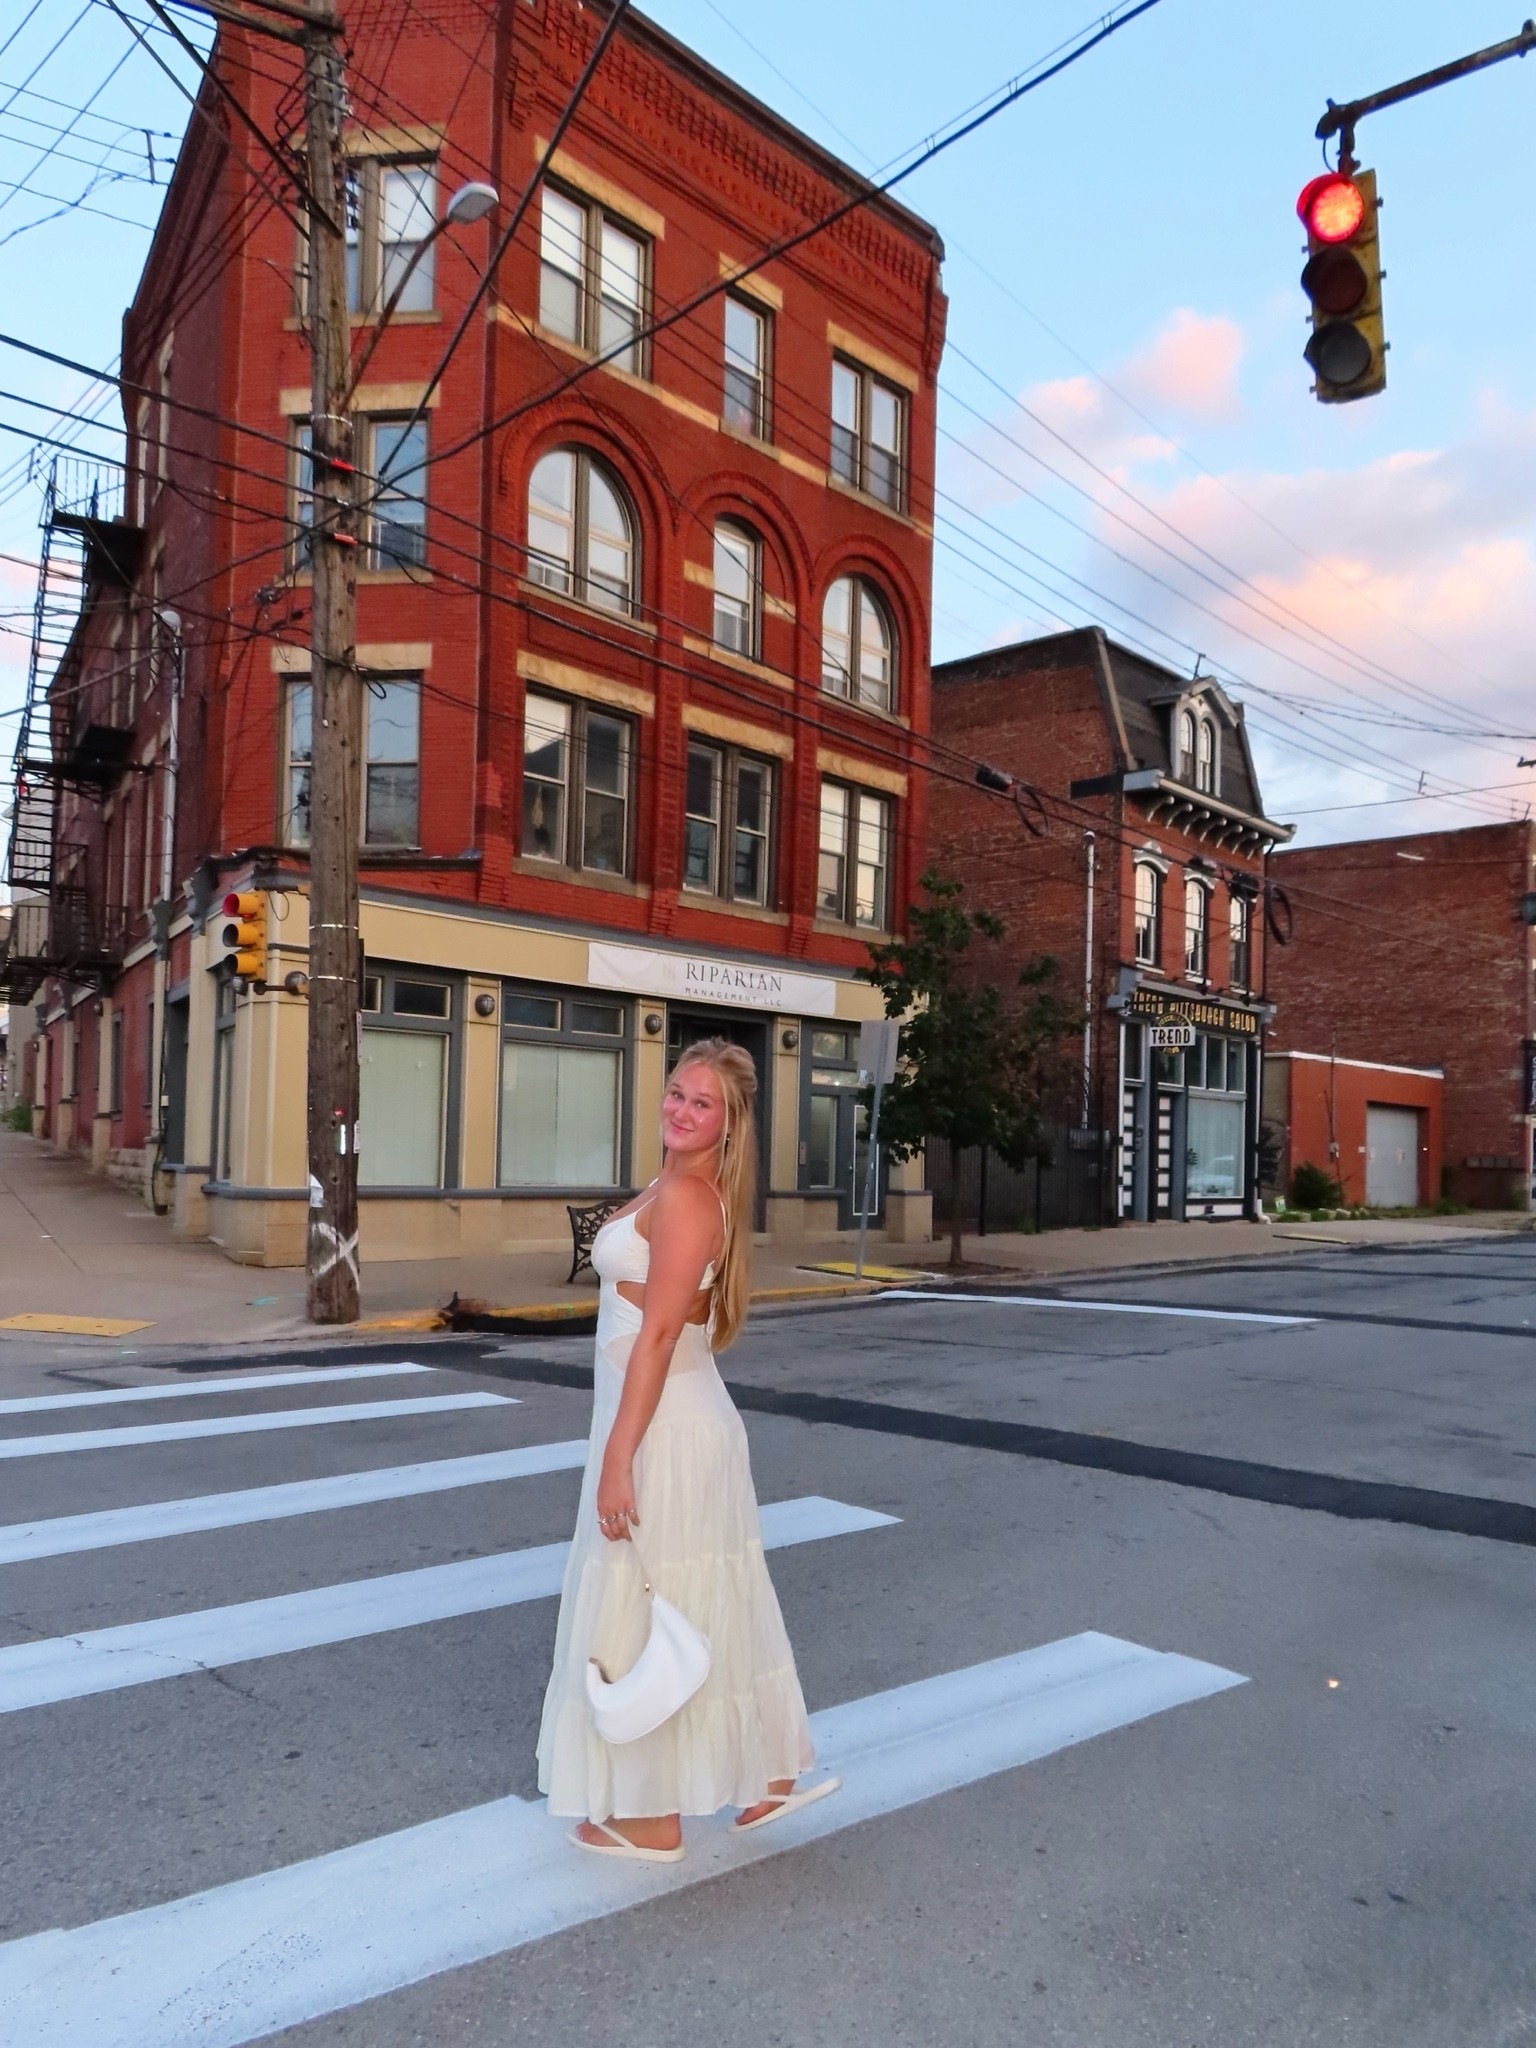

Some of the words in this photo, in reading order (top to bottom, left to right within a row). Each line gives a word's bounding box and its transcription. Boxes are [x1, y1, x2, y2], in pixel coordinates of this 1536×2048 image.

[686, 962, 782, 992] RIPARIAN
[685, 987, 757, 1002] MANAGEMENT
[764, 998, 781, 1006] LLC
[1229, 1011, 1256, 1033] SALON
[1152, 1028, 1191, 1044] TREND
